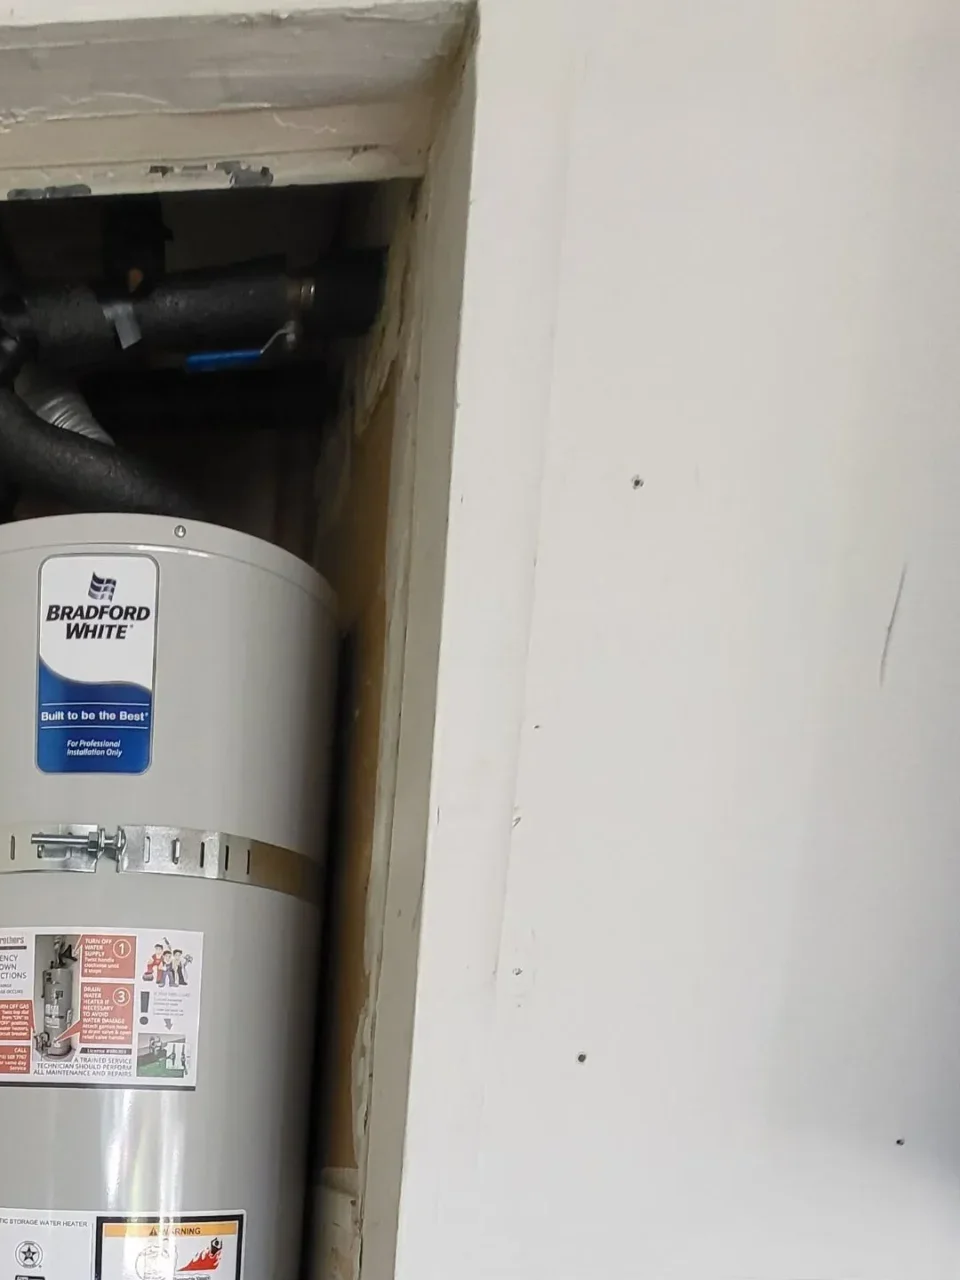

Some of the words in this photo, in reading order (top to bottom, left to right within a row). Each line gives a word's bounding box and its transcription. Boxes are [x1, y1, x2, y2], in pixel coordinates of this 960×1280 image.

[46, 604, 150, 621] BRADFORD
[66, 623, 128, 640] WHITE
[41, 711, 64, 720] Built
[67, 711, 78, 720] to
[82, 710, 96, 720] be
[99, 711, 116, 720] the
[66, 740, 78, 748] For
[79, 740, 120, 748] Professional
[66, 748, 105, 756] Installation
[106, 748, 122, 758] Only
[119, 943, 124, 954] 1
[118, 990, 125, 1002] 3
